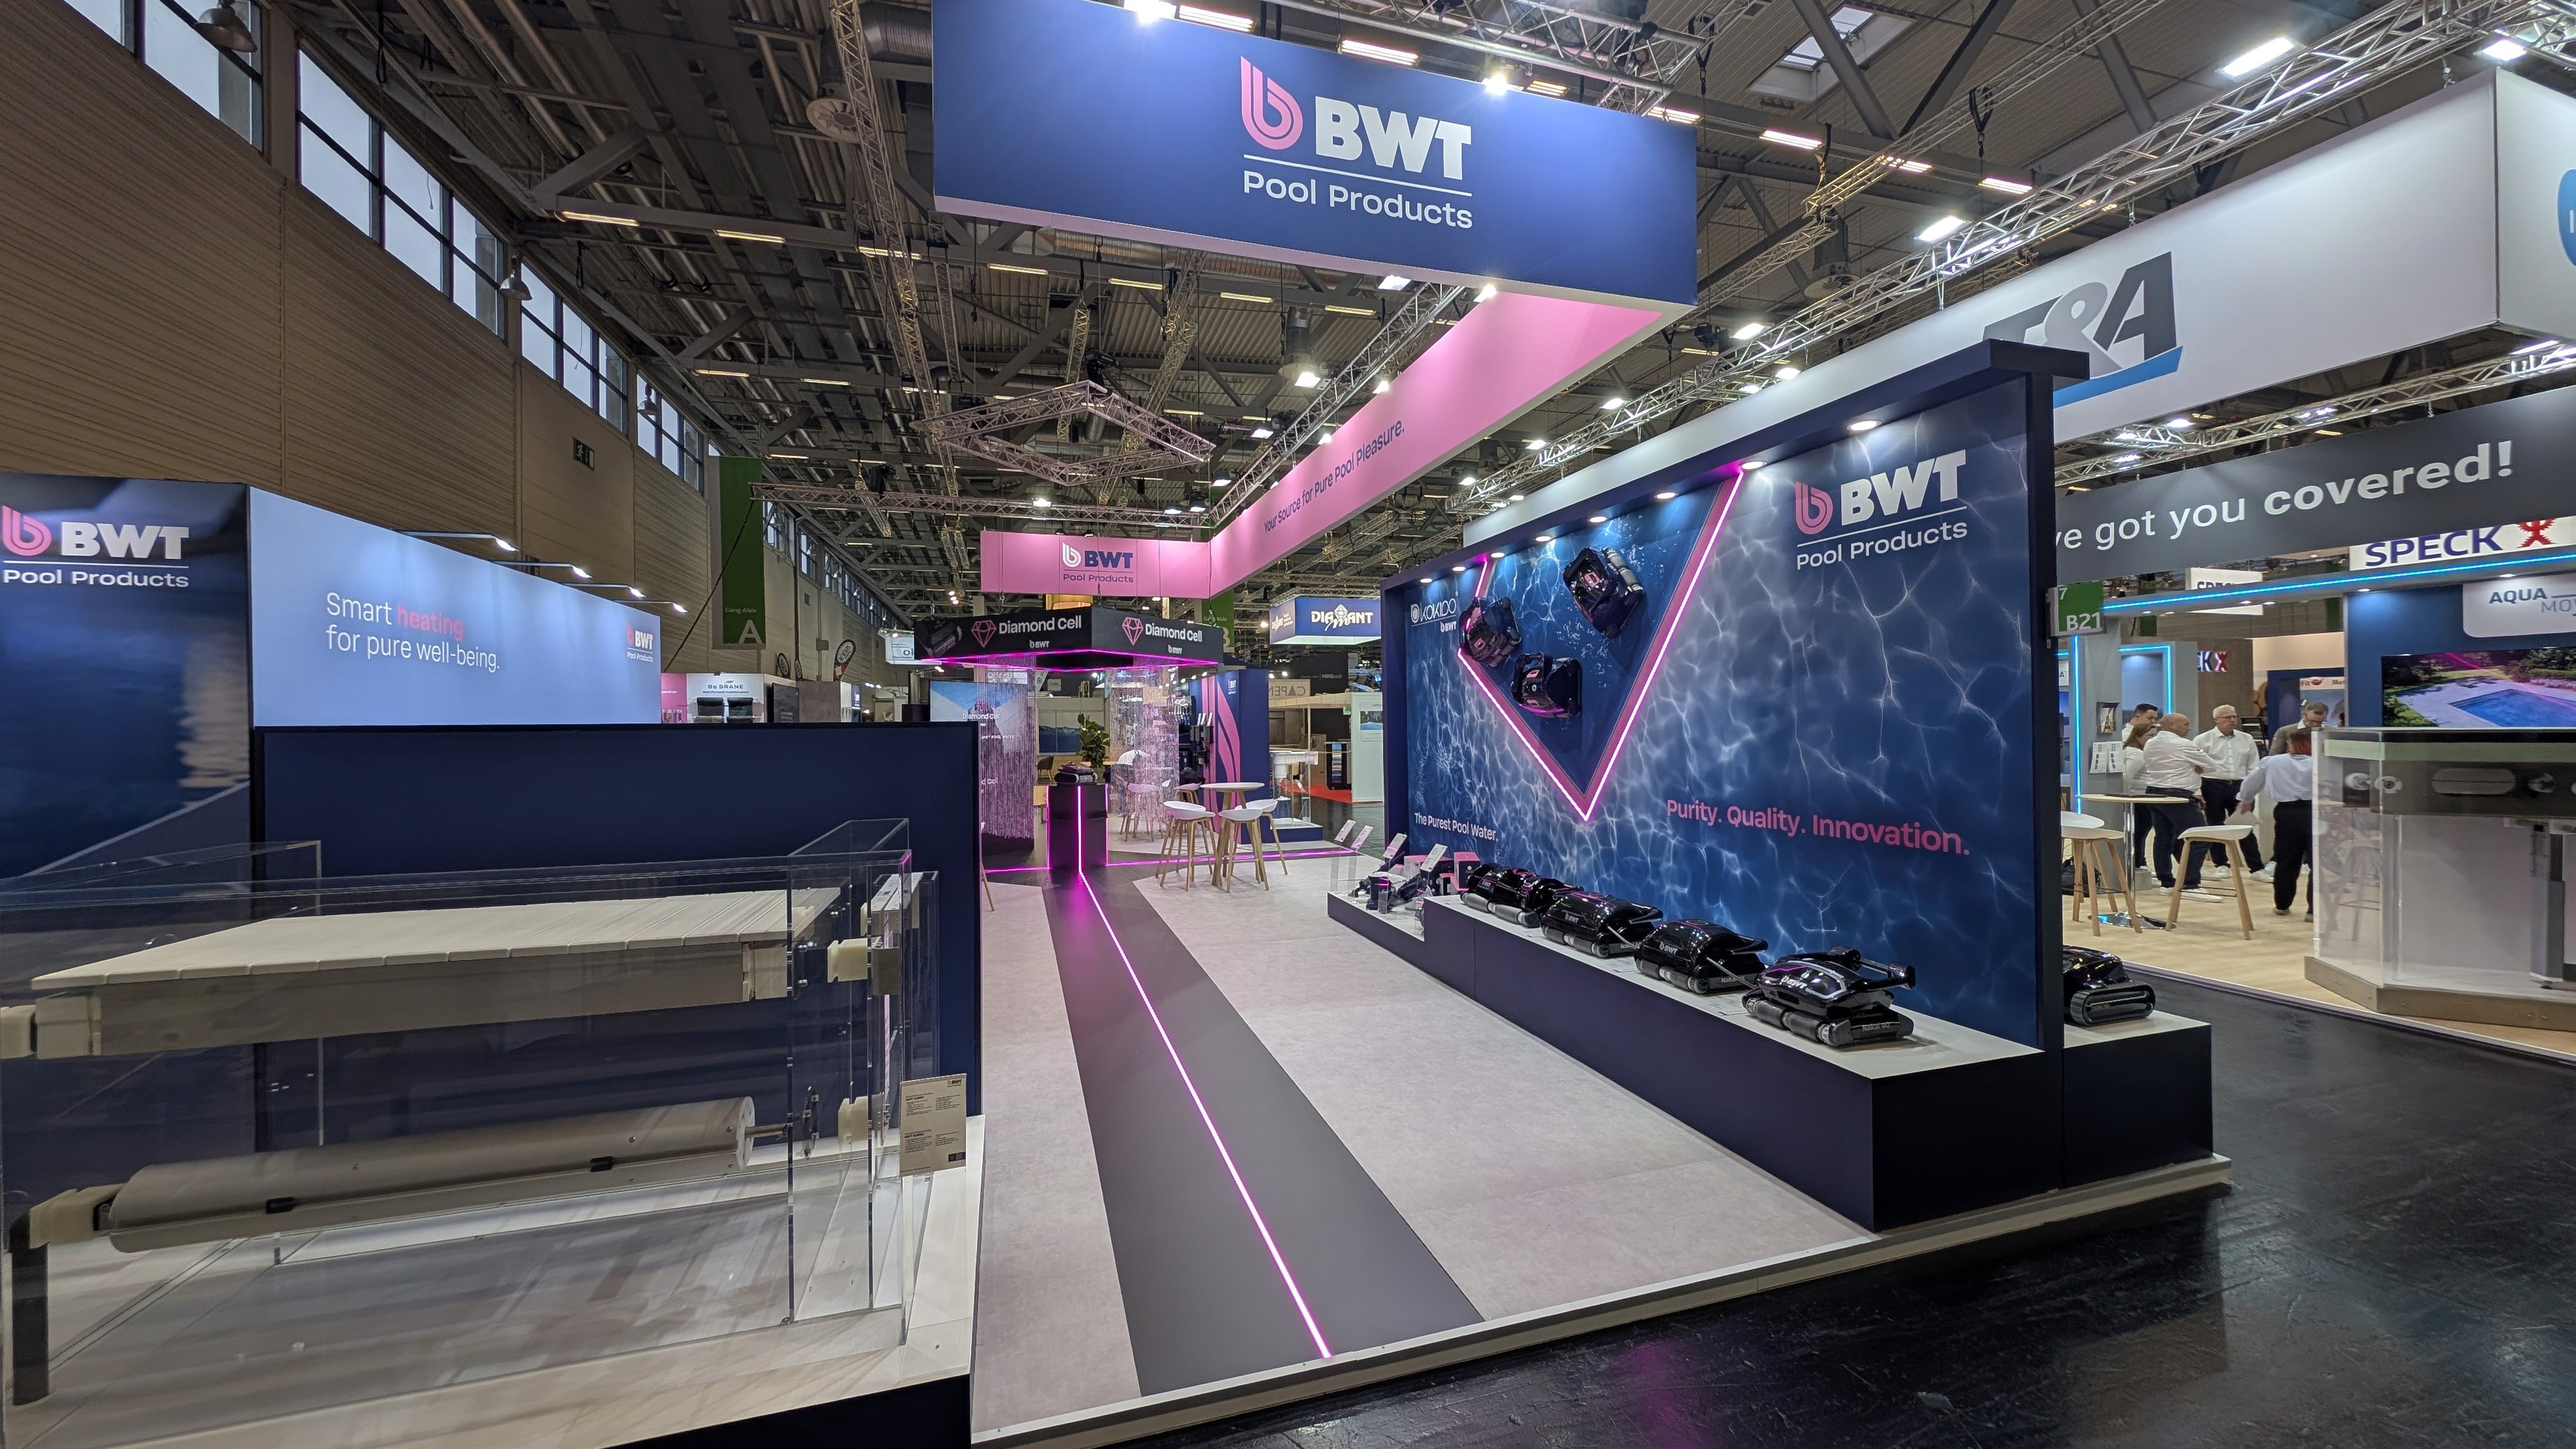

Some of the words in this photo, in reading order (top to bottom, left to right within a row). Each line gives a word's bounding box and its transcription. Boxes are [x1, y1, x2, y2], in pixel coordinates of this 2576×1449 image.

[1315, 96, 1471, 181] BWT
[1243, 169, 1316, 205] Pool
[1329, 185, 1473, 229] Products
[1264, 515, 1278, 534] Your
[1302, 487, 1313, 507] for
[1314, 474, 1333, 498] Pure
[1335, 452, 1354, 483] Pool
[1356, 420, 1405, 467] Pleasure.
[1841, 448, 1967, 526] BWT
[2095, 510, 2156, 551] got
[2169, 498, 2245, 540] you
[2264, 440, 2513, 516] covered!
[61, 521, 190, 560] BWT
[1797, 549, 1843, 571] Pool
[1850, 521, 1968, 560] Products
[2365, 525, 2504, 567] SPECK
[1084, 551, 1133, 569] BWT
[3, 569, 63, 585] Pool
[71, 571, 190, 588] Products
[1063, 572, 1086, 582] Pool
[1088, 574, 1134, 583] Products
[2058, 587, 2068, 600] 7
[2488, 587, 2548, 604] AQUA
[2541, 598, 2576, 613] MO
[326, 592, 392, 626] Smart
[397, 603, 464, 641] heating
[999, 616, 1055, 635] Diamond
[1058, 615, 1082, 631] Cell
[1310, 610, 1374, 632] DIAMANT
[2066, 611, 2101, 631] B21
[635, 630, 654, 650] BWT
[1145, 623, 1186, 640] Diamond
[1186, 627, 1203, 643] Cell
[326, 624, 361, 652] for
[367, 634, 413, 660] pure
[415, 640, 500, 673] well-being.
[1414, 812, 1427, 825] The
[1428, 815, 1452, 831] Purest
[1452, 820, 1469, 835] Pool
[1471, 824, 1499, 842] Water.
[1666, 799, 1722, 825] Purity.
[1726, 805, 1805, 837] Quality.
[1813, 814, 1970, 855] Innovation.
[1664, 945, 1678, 954] BWT
